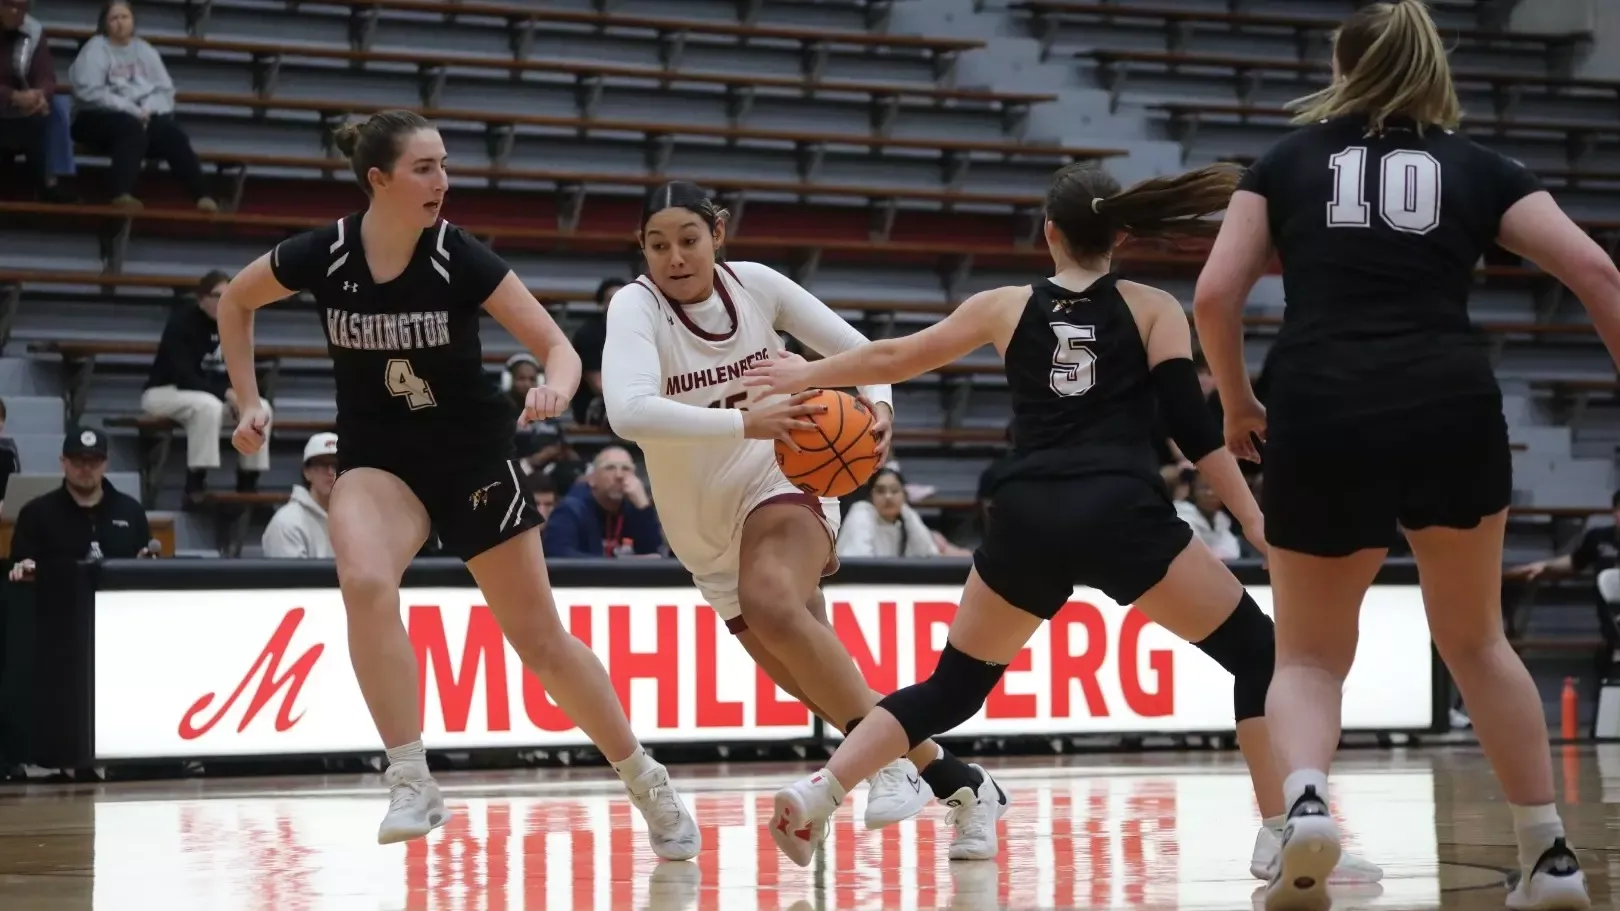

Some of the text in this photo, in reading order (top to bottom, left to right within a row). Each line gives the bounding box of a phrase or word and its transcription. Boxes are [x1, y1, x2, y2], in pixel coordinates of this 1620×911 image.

[1326, 145, 1442, 236] 10
[326, 307, 451, 351] WASHINGTON
[1049, 321, 1098, 397] 5
[384, 358, 438, 411] 4
[178, 606, 325, 741] M
